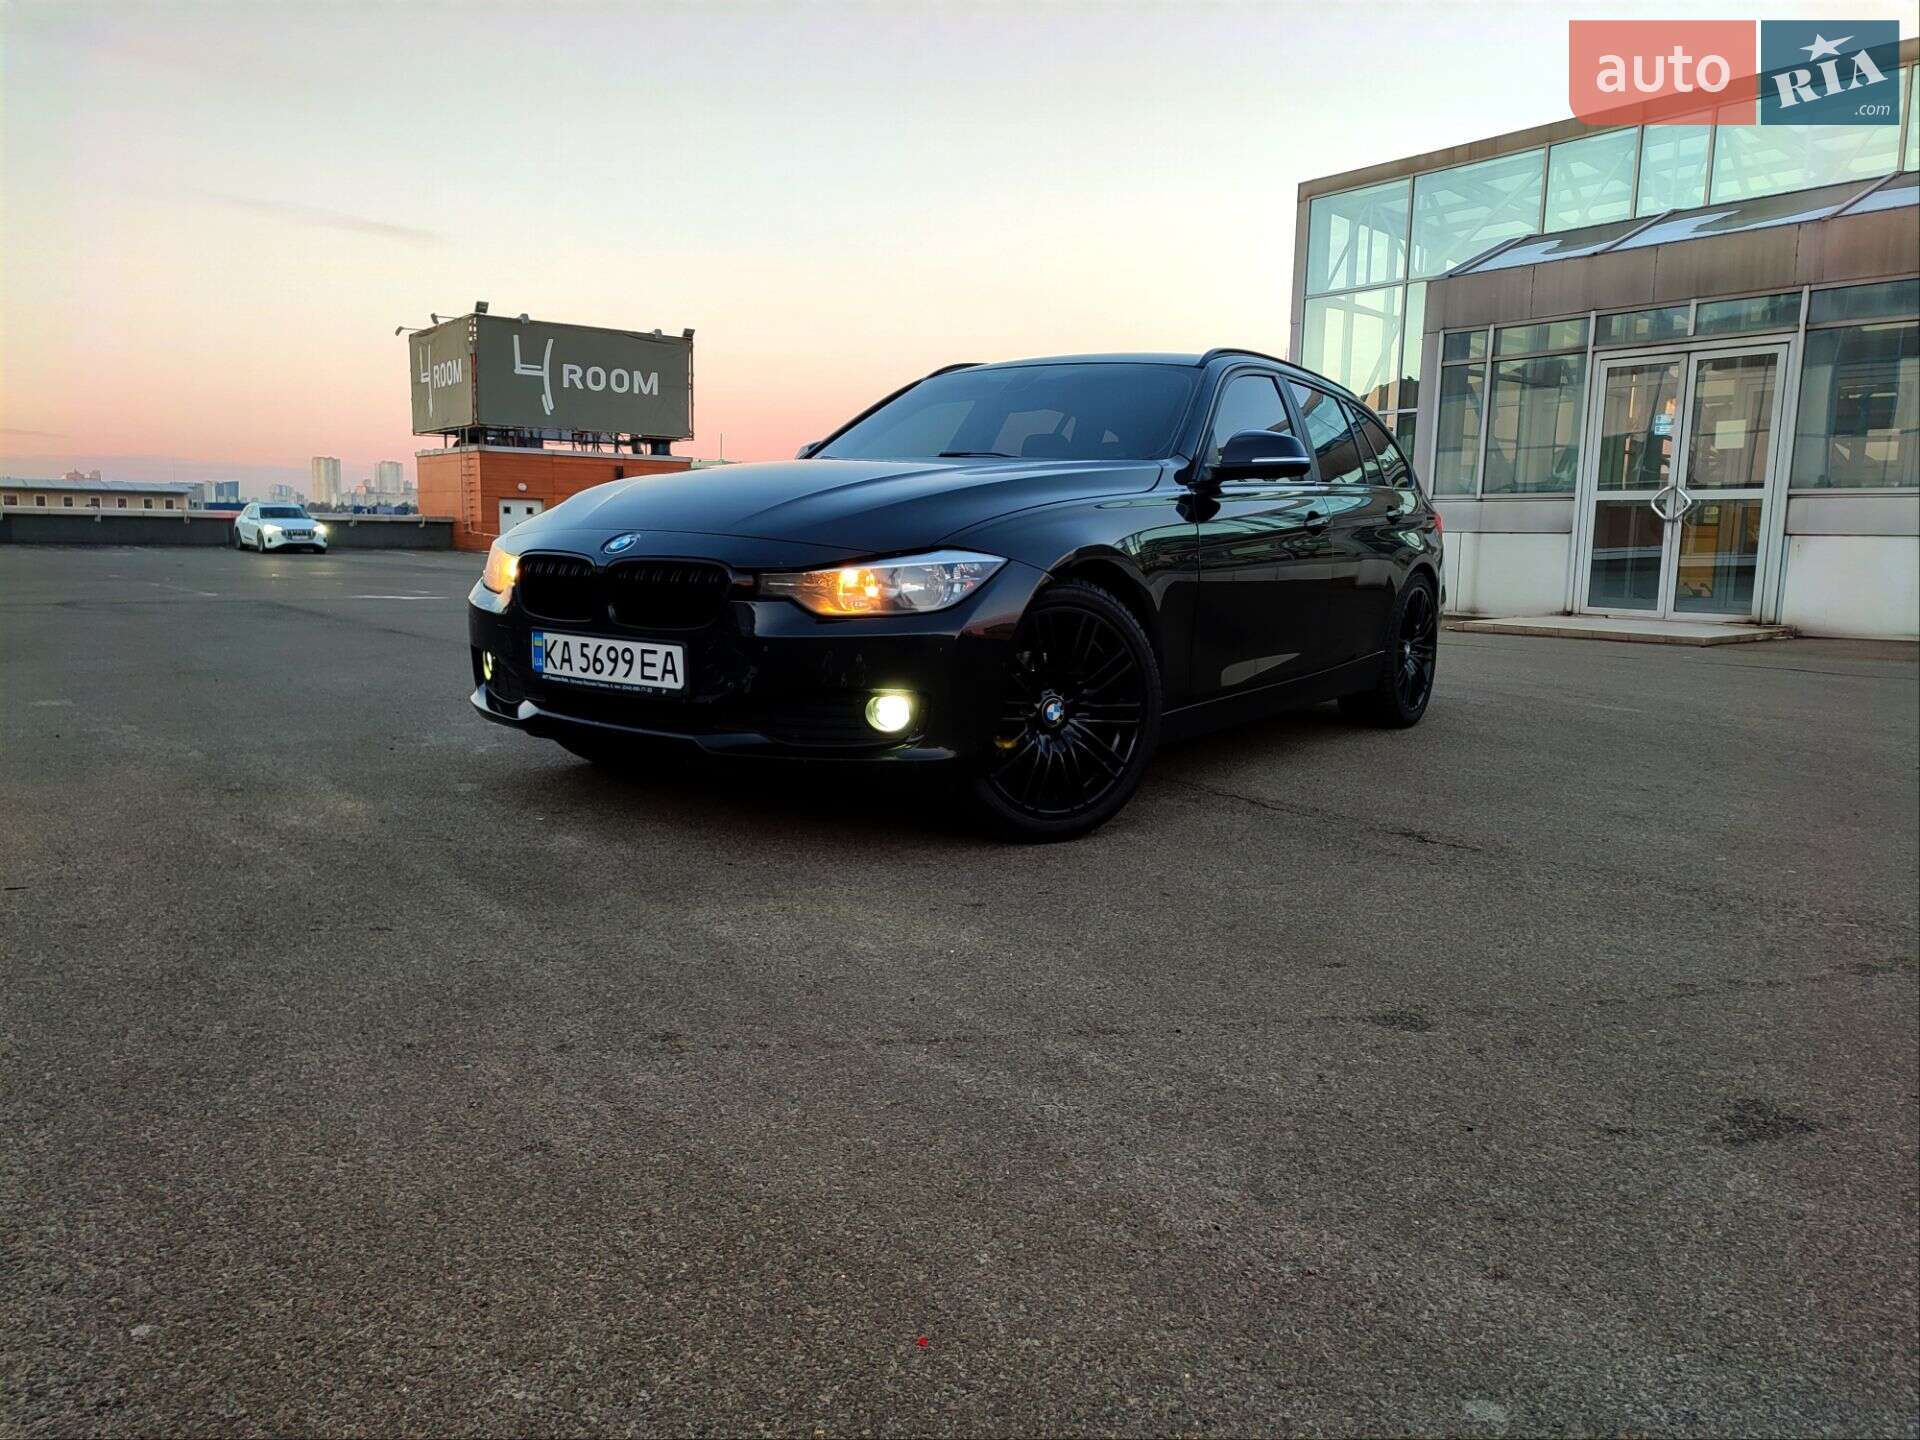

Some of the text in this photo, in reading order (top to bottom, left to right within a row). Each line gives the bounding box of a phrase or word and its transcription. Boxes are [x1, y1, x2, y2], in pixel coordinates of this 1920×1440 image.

[433, 358, 463, 389] ROOM
[562, 363, 659, 396] ROOM
[544, 639, 573, 671] KA
[579, 643, 634, 678] 5699
[640, 648, 678, 683] EA
